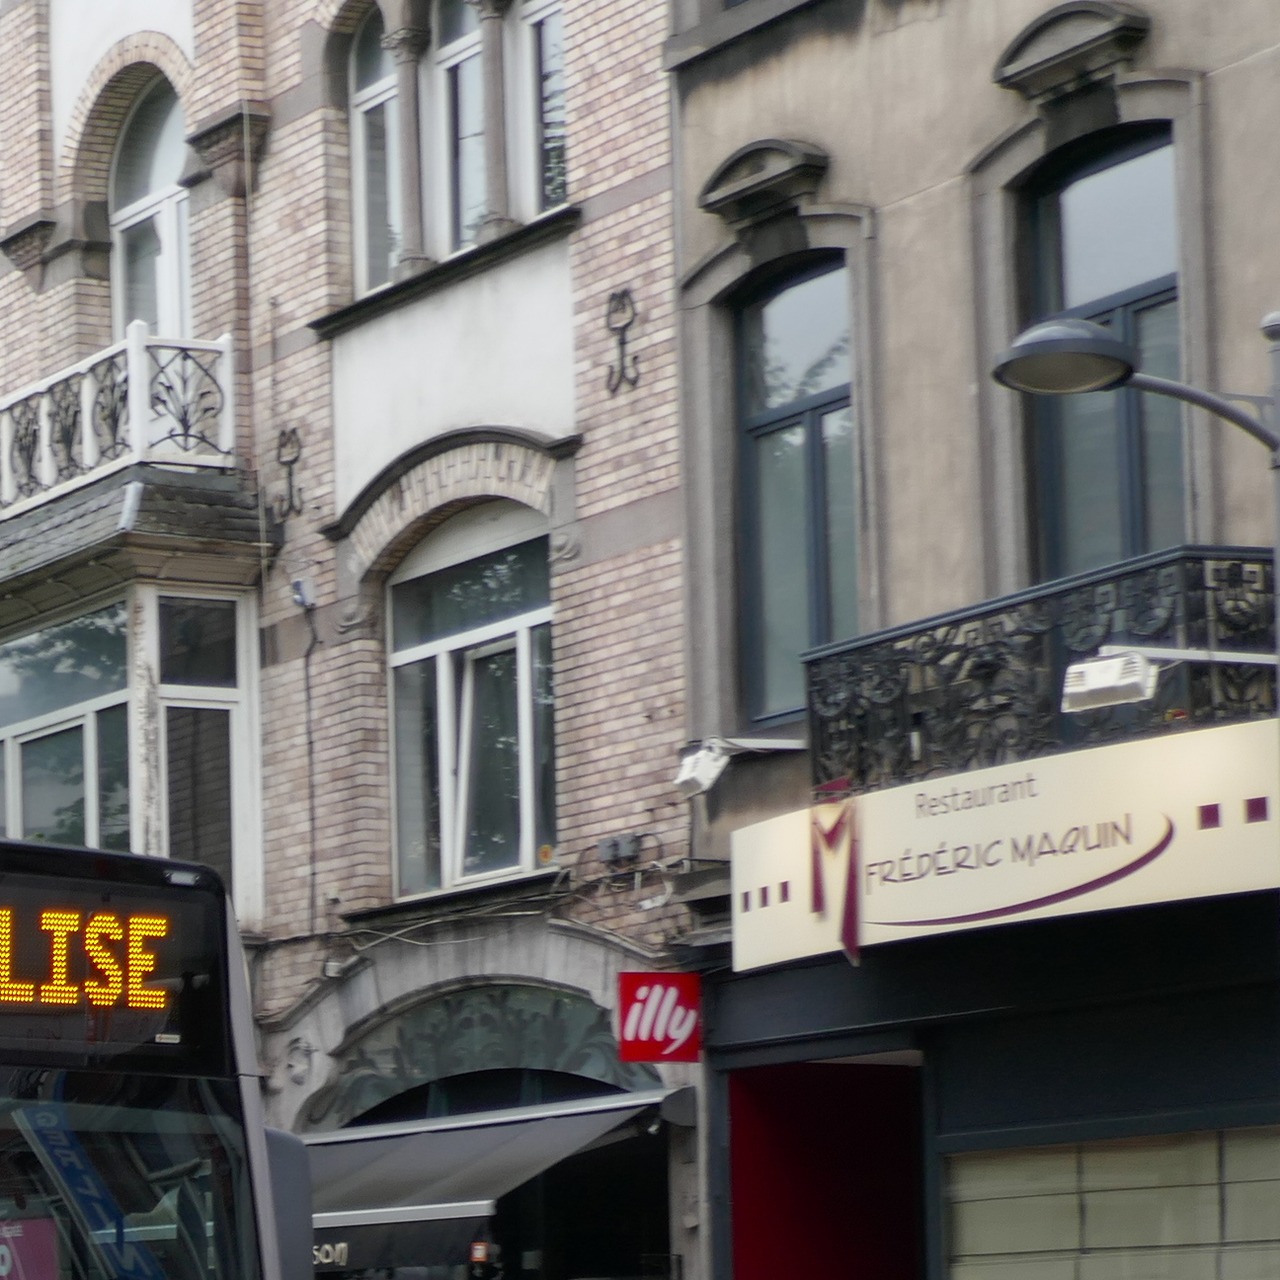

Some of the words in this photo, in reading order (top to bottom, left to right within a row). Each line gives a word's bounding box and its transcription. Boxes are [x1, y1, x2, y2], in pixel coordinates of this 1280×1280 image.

[914, 772, 1040, 819] Restaurant
[865, 838, 1004, 896] FRÉDÉRIC
[1009, 812, 1133, 868] MAQUIN
[623, 983, 698, 1055] illy
